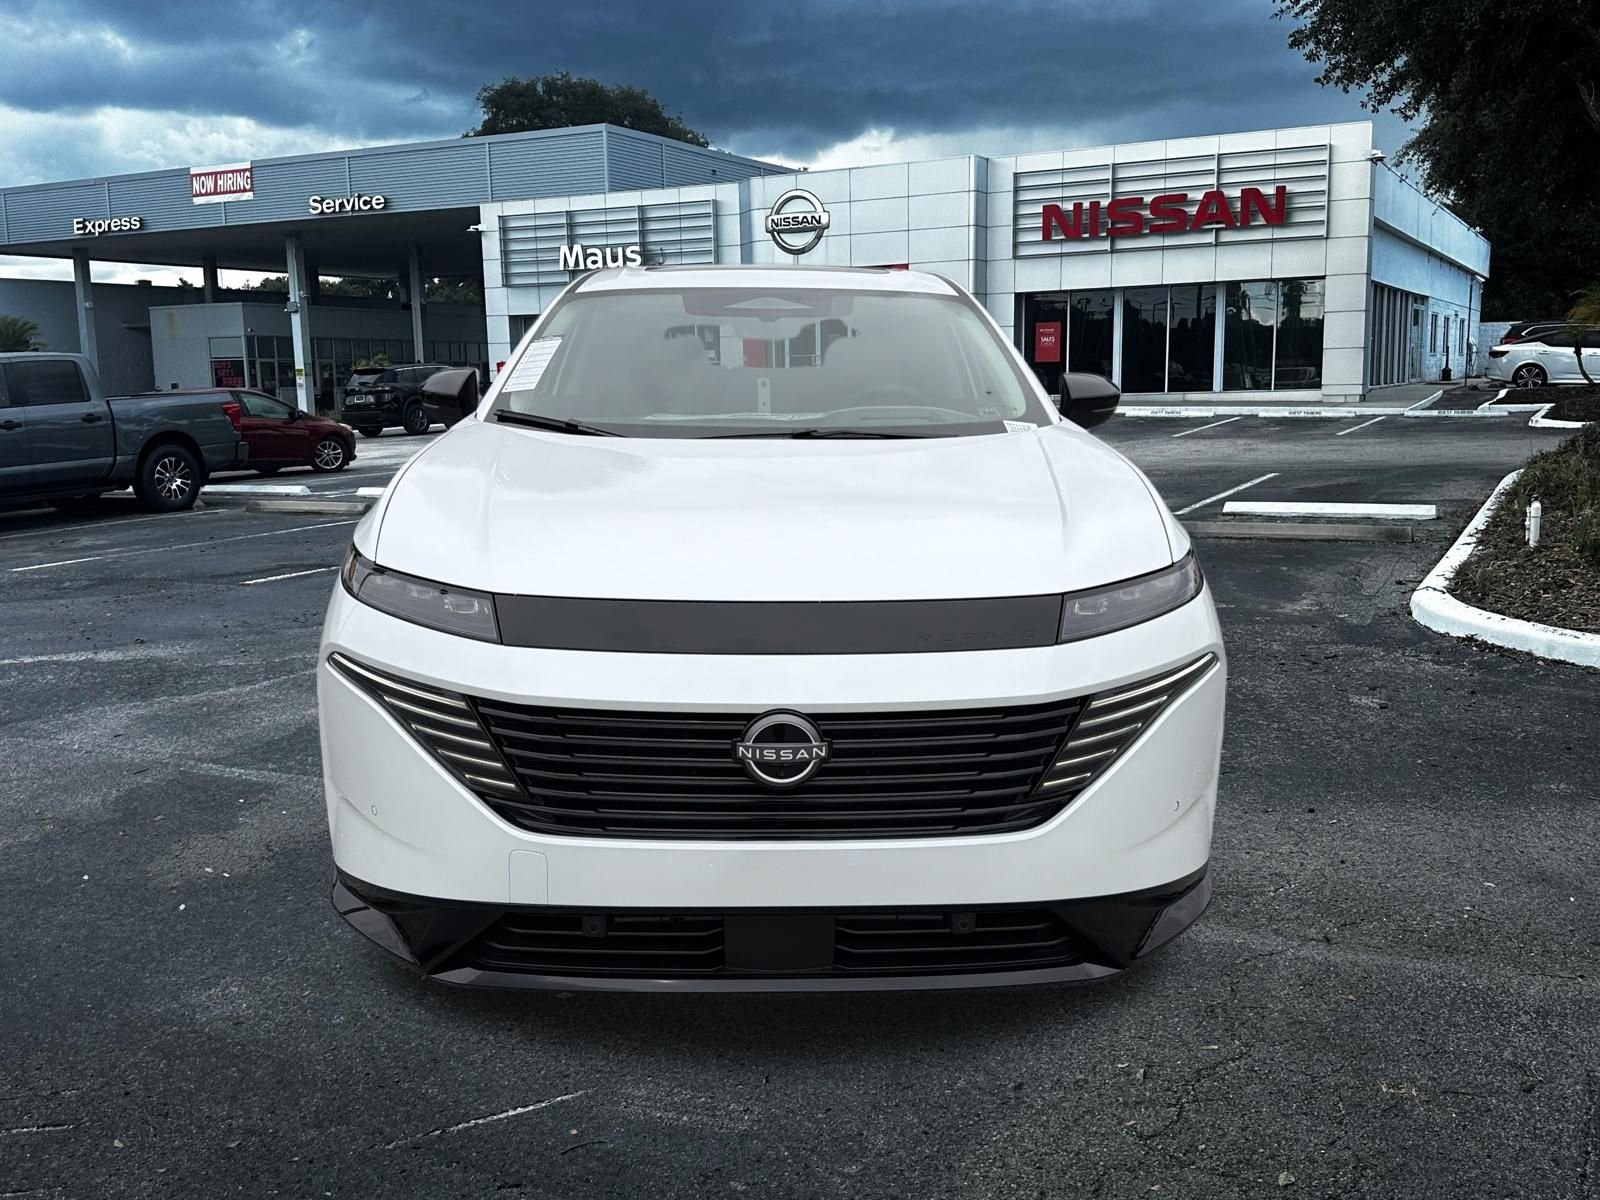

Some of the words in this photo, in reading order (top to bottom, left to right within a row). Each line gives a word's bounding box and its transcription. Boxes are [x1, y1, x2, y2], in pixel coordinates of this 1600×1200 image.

[192, 174, 215, 195] NOW
[217, 171, 251, 192] HIRING
[308, 193, 385, 214] Service
[1041, 185, 1287, 241] NISSAN
[73, 216, 141, 237] Express
[770, 215, 822, 228] NISSAN
[559, 243, 642, 271] Maus
[738, 746, 826, 760] NISSAN
